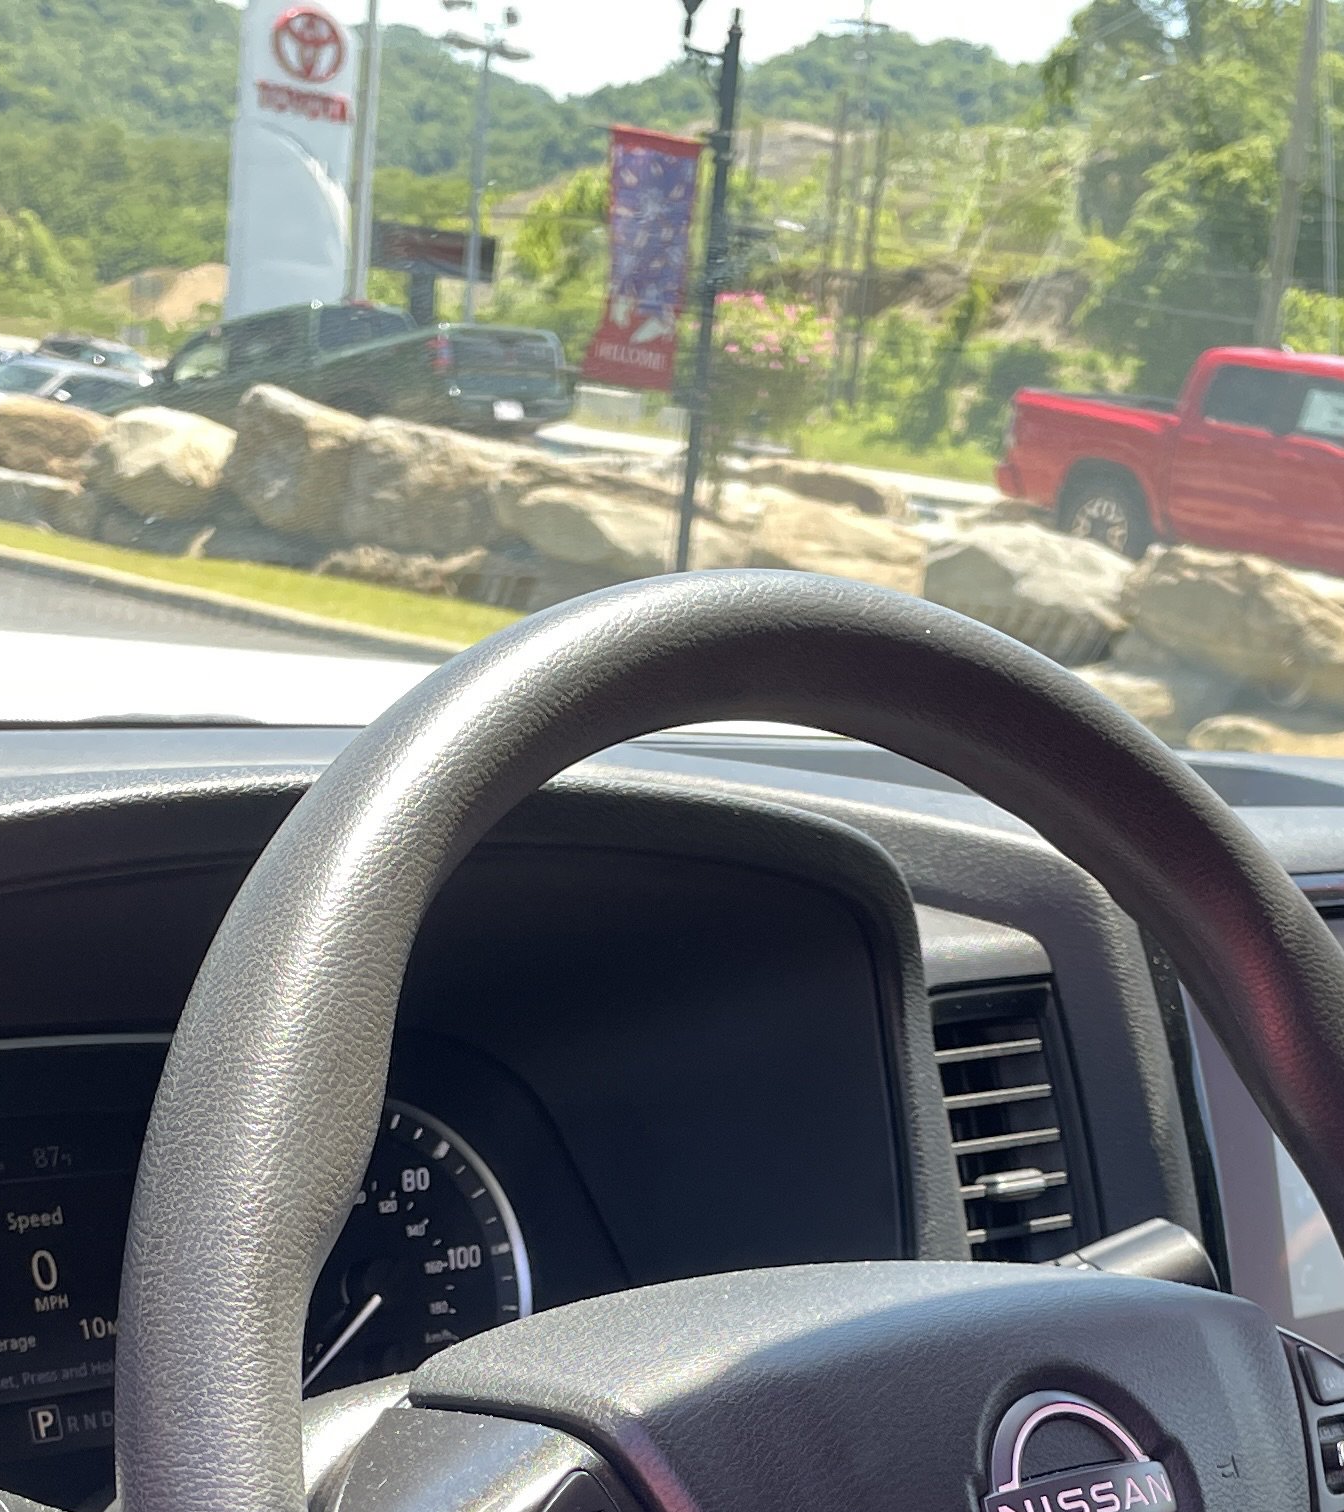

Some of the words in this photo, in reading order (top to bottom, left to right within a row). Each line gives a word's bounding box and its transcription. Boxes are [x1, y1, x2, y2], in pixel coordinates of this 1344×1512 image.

[255, 80, 347, 122] TOYOTA
[401, 1167, 430, 1192] 80
[7, 1206, 63, 1234] Speed
[31, 1249, 58, 1292] 0
[447, 1245, 482, 1271] 100
[34, 1293, 70, 1313] MPH
[62, 1361, 88, 1379] and
[36, 1410, 54, 1440] P
